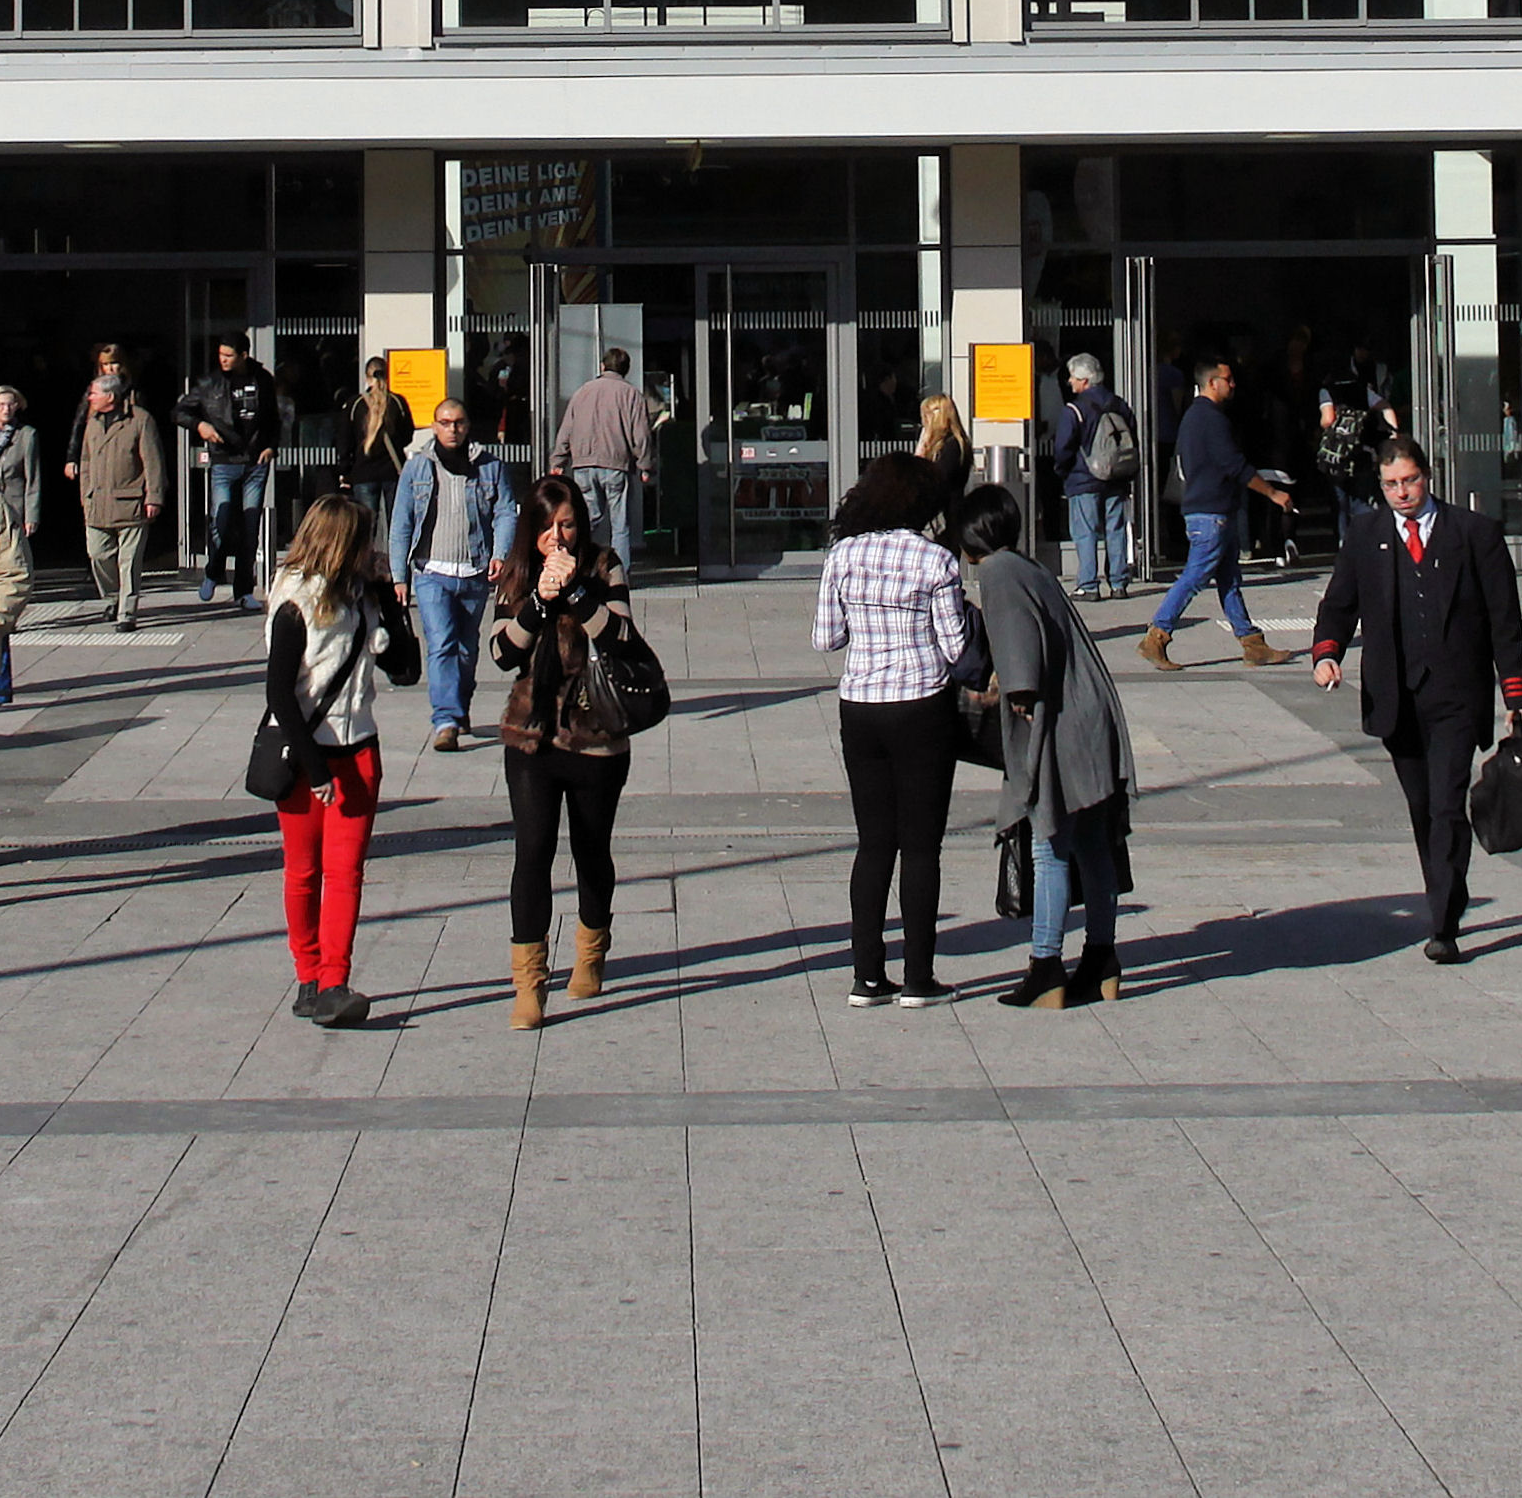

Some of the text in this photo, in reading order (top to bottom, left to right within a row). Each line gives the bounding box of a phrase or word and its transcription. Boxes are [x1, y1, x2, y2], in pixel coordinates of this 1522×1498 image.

[462, 162, 582, 188] DEINE LIGA.
[463, 191, 518, 216] DEIN
[465, 217, 518, 243] DEIN
